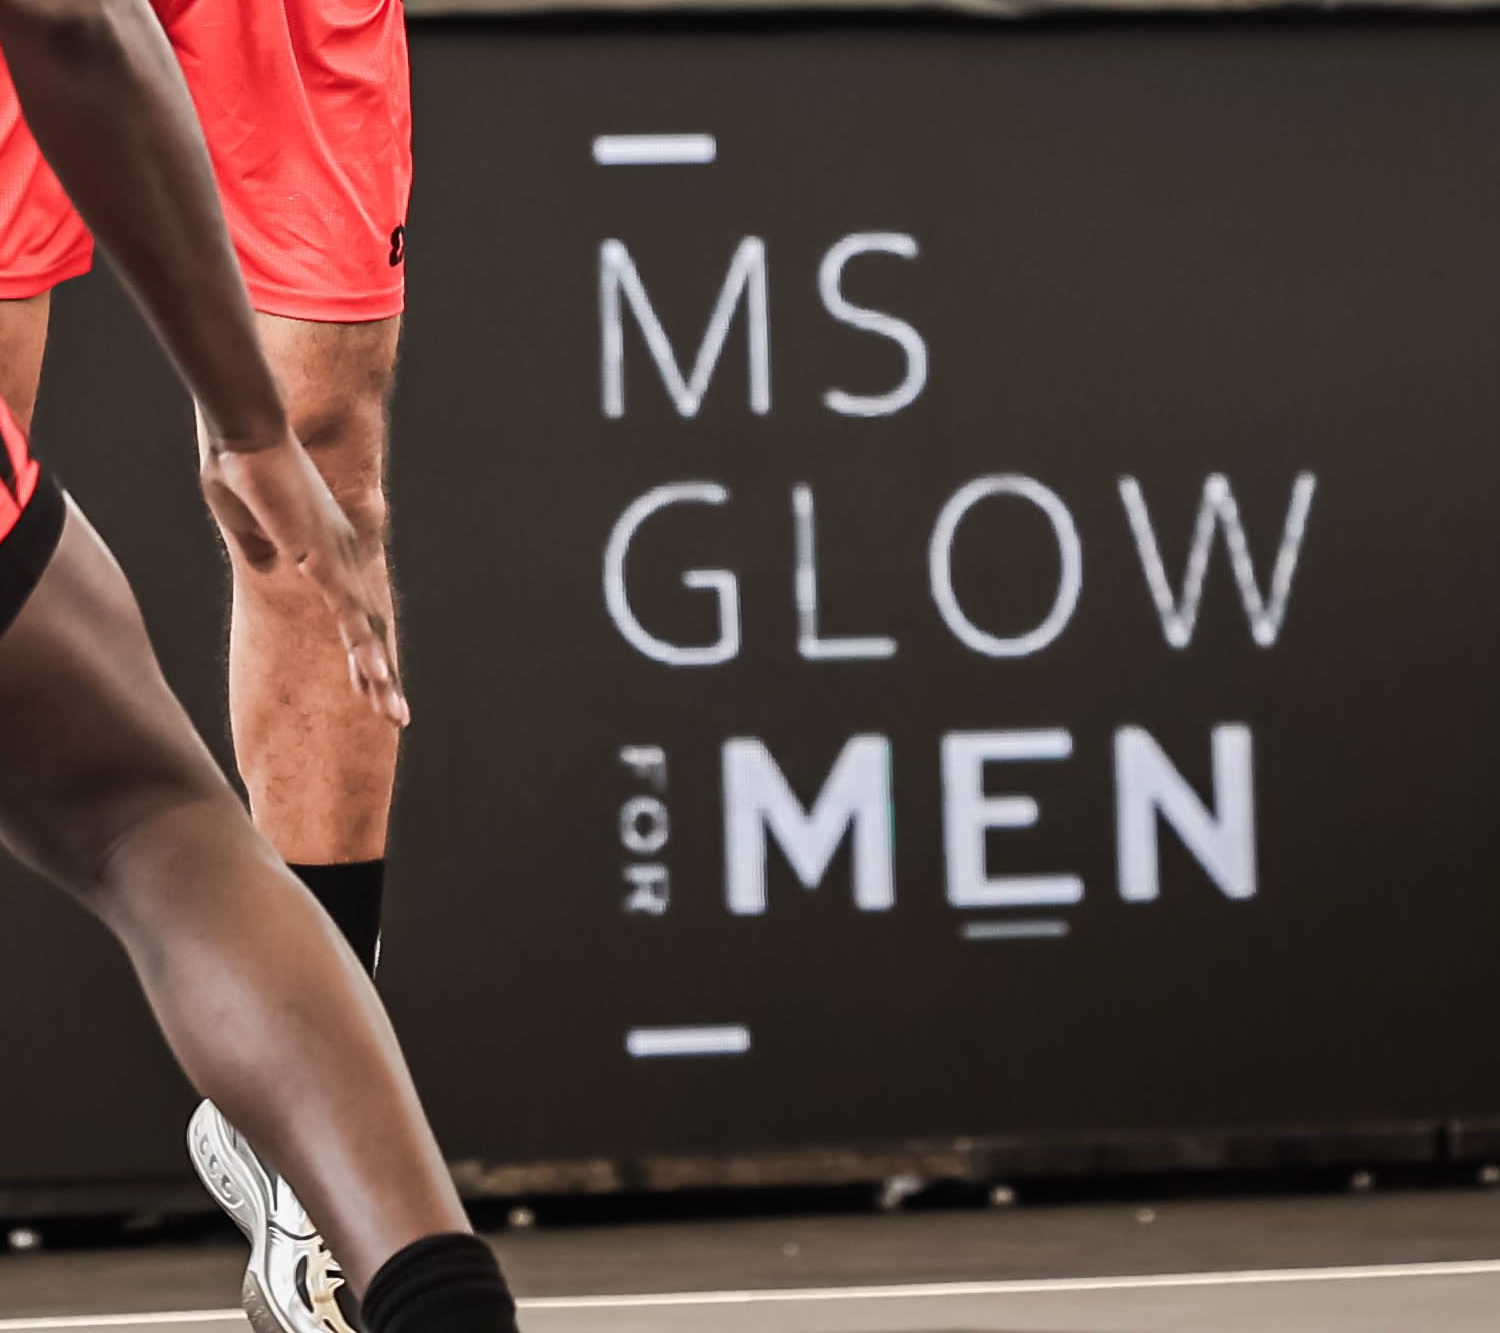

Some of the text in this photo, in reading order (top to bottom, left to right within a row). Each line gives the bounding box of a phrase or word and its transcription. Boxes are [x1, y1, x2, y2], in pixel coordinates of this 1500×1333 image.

[600, 232, 929, 418] MS
[603, 471, 1316, 665] GLOW
[721, 724, 1258, 915] MEN
